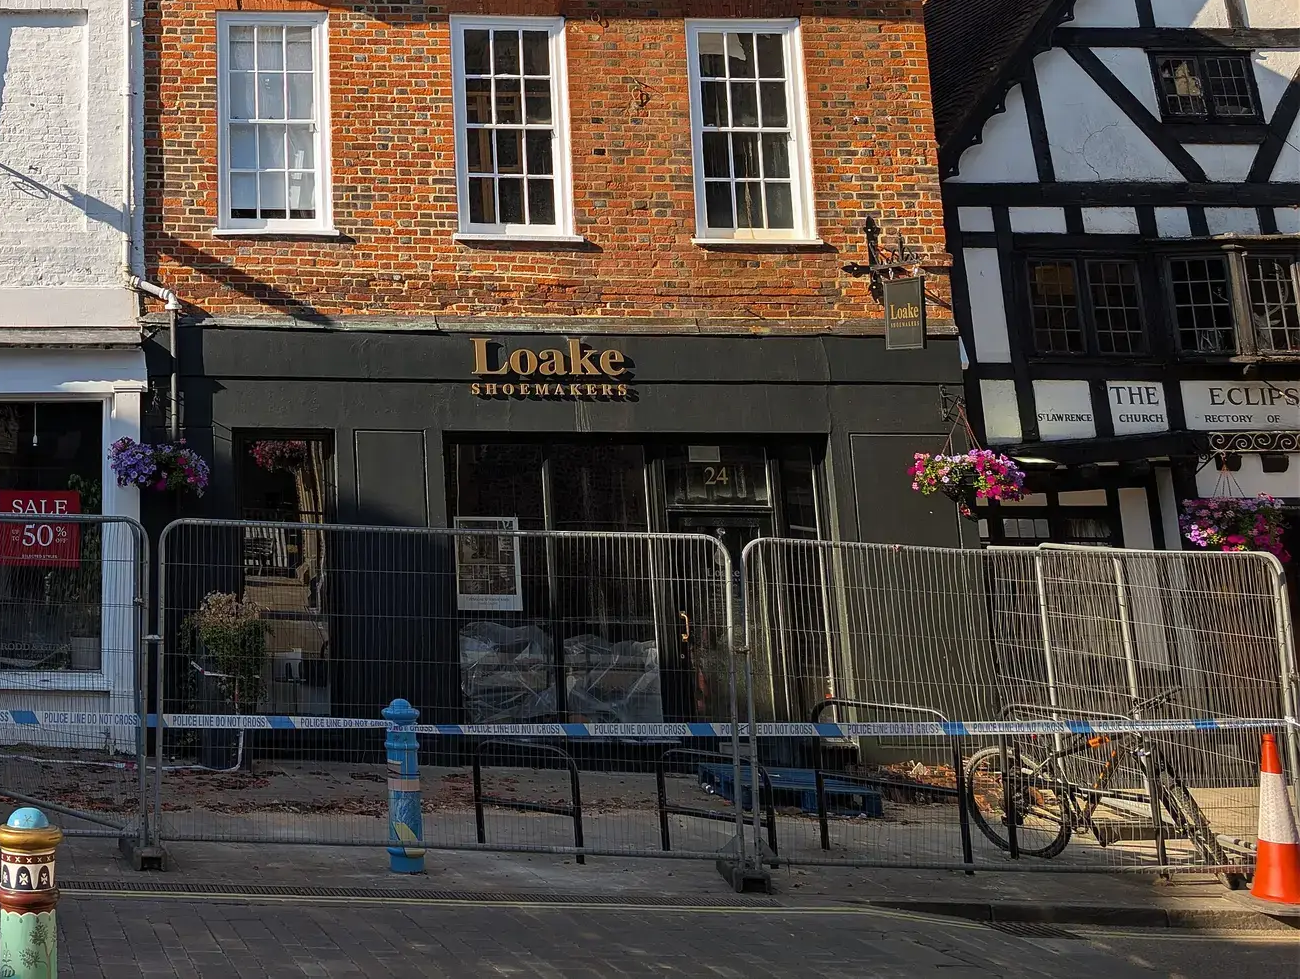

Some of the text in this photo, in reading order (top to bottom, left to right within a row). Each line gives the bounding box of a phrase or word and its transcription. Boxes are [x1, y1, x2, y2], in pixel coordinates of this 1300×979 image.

[890, 303, 919, 320] Loake
[470, 337, 625, 376] Loake
[471, 382, 628, 396] SHOEMAKERS
[1109, 386, 1300, 406] THE ECLIPS
[1047, 414, 1093, 422] LAWRENCE
[1119, 414, 1164, 423] CHURCH
[1204, 415, 1254, 423] RECTORY
[1267, 415, 1281, 423] OF
[704, 466, 728, 485] 24
[11, 499, 68, 514] SALE
[45, 712, 138, 725] POLICE LINE DO NOT CROSS
[173, 715, 266, 727] POLICE LINE DO NOT CROSS
[300, 718, 326, 728] POLICE
[327, 719, 342, 728] LINE
[344, 719, 353, 727] DO
[468, 724, 560, 734] POLICE LINE DO NOT CROSS
[594, 724, 687, 735] POLICE LINE DO NOT CROSS
[763, 724, 773, 735] DO
[775, 724, 788, 735] NOT
[790, 724, 813, 735] CROSS
[848, 724, 939, 734] POLICE LINE DO NOT CROSS
[973, 722, 1065, 733] POLICE LINE DO NOT CROSS
